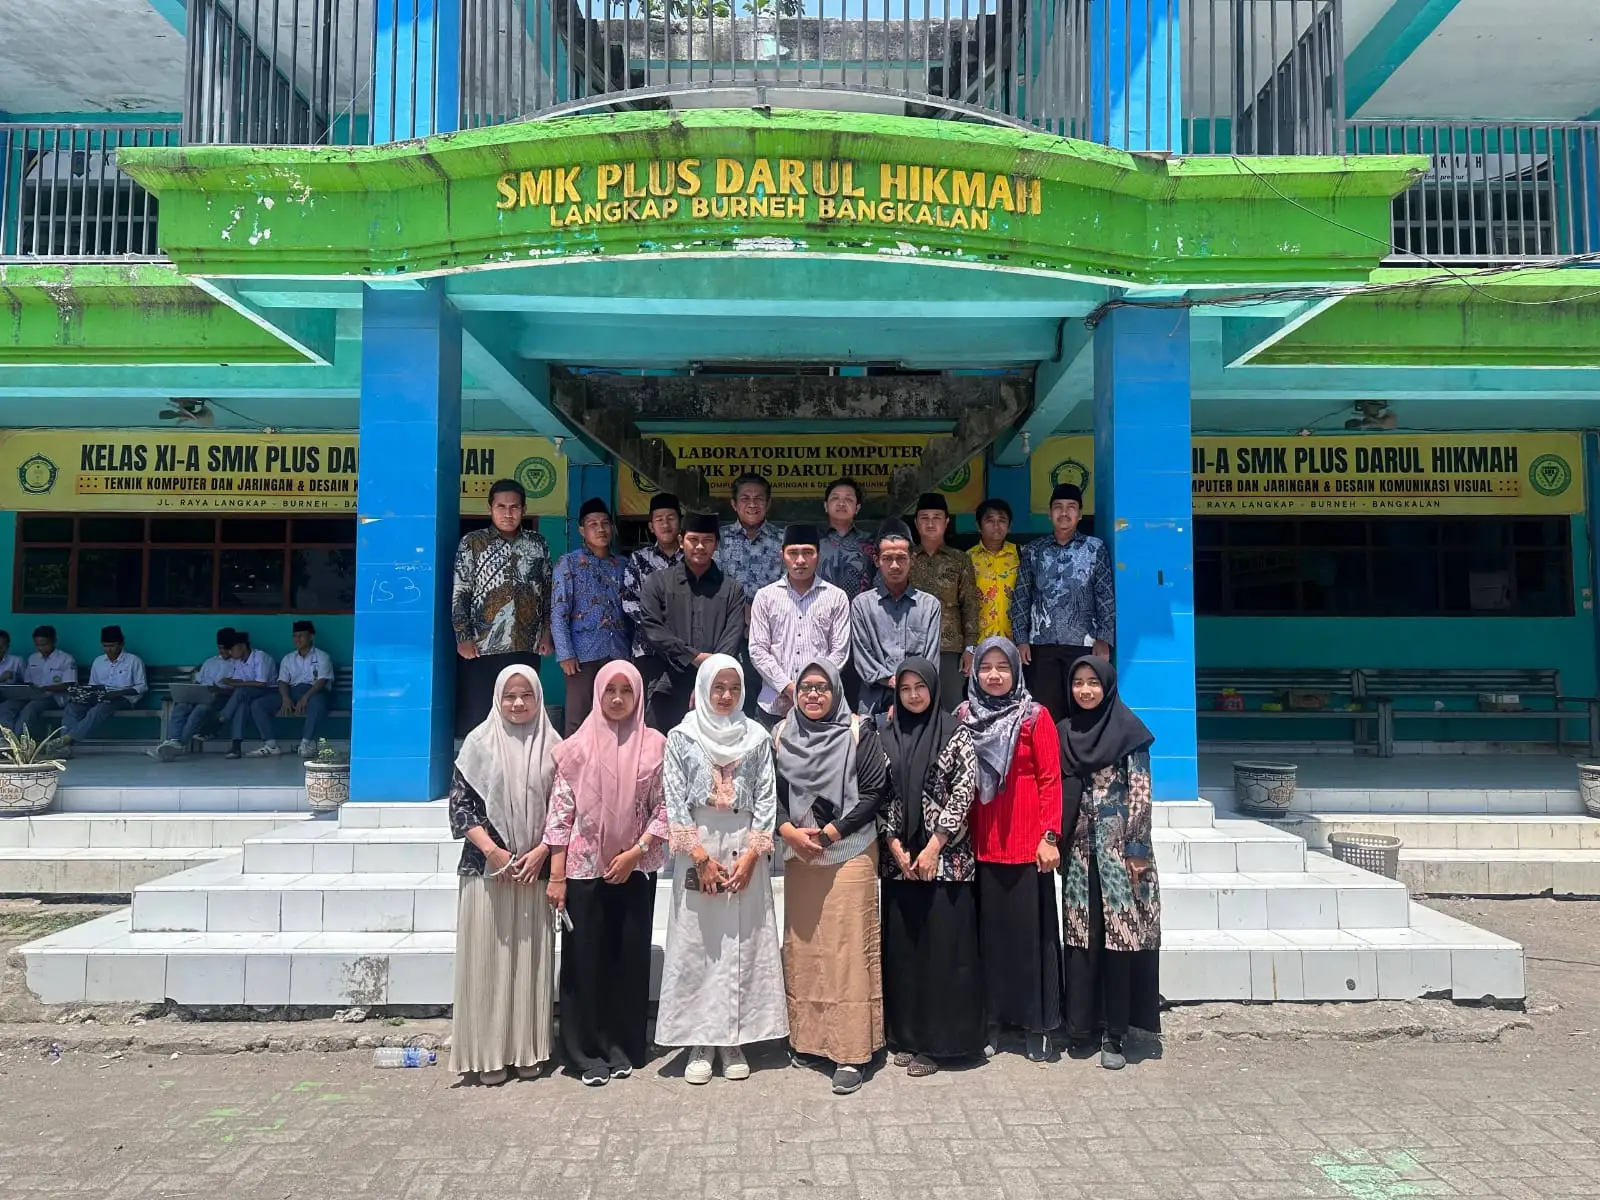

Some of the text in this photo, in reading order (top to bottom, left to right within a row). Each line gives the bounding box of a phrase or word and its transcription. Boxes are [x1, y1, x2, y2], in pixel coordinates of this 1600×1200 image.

[496, 158, 1042, 215] SMK PLUS DARUL HIKMAH
[550, 197, 988, 230] LANGKAP BURNEH BANGKALAN
[80, 444, 148, 471] KELAS
[154, 444, 200, 472] XI-A
[207, 445, 259, 473] SMK
[265, 445, 320, 473] PLUS
[678, 445, 922, 459] LABORATORIUM KOMPUTER
[1237, 447, 1285, 474] SMK
[1295, 447, 1348, 474] PLUS
[1355, 446, 1424, 473] DARUL
[1432, 446, 1518, 473] HIKMAH
[729, 464, 773, 477] PLUS
[777, 464, 837, 477] DARUL
[104, 477, 143, 490] TEKNIK
[147, 477, 207, 491] KOMPUTER
[211, 478, 233, 491] DAN
[237, 478, 293, 492] JARINGAN
[297, 480, 305, 492] &
[309, 479, 349, 492] DESAIN
[1237, 479, 1259, 493] DAN
[1263, 479, 1319, 493] JARINGAN
[1324, 480, 1331, 493] &
[1335, 479, 1375, 493] DESAIN
[1379, 479, 1450, 493] KOMUNIKASI
[1454, 479, 1493, 493] VISUAL
[157, 498, 174, 507] JL.
[180, 498, 209, 507] RAYA
[214, 499, 267, 508] LANGKAP
[282, 500, 328, 508] BURNEH
[1207, 500, 1236, 509] RAYA
[1241, 500, 1295, 509] LANGKAP
[1311, 500, 1356, 508] BURNEH
[1372, 500, 1441, 508] BANGKALAN
